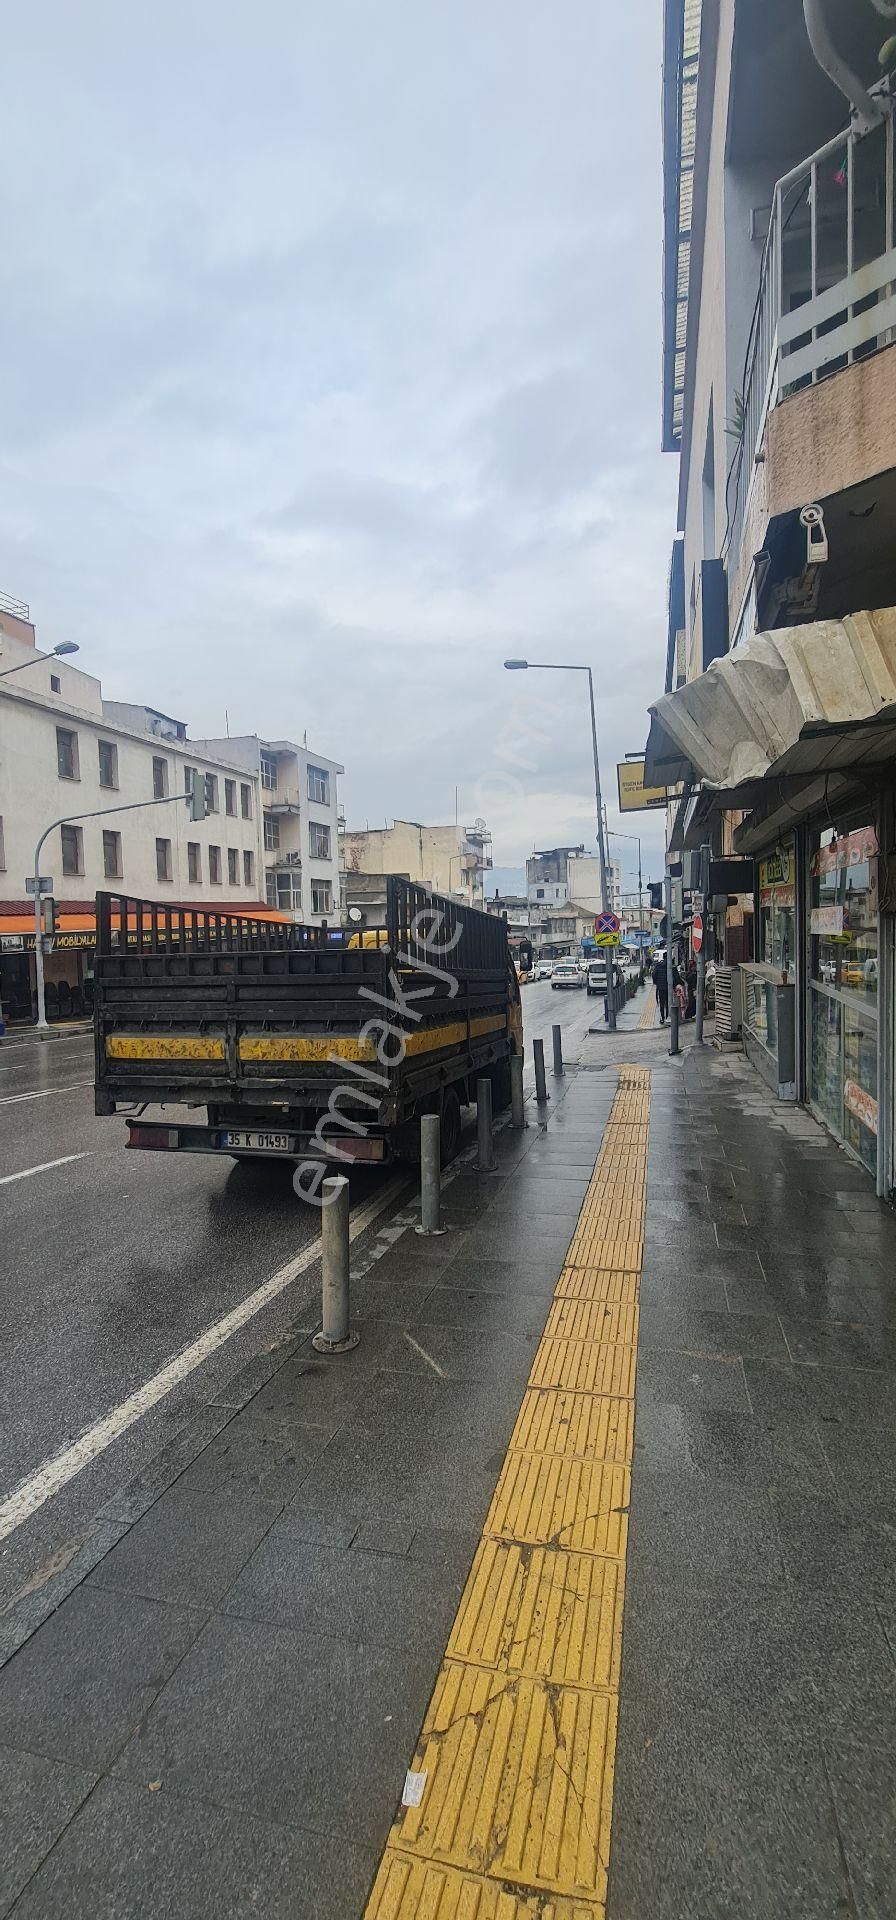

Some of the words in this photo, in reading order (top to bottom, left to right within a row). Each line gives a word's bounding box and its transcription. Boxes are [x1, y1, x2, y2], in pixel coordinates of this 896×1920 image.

[228, 1133, 240, 1146] 35
[245, 1134, 252, 1147] K
[258, 1135, 287, 1149] 01493
